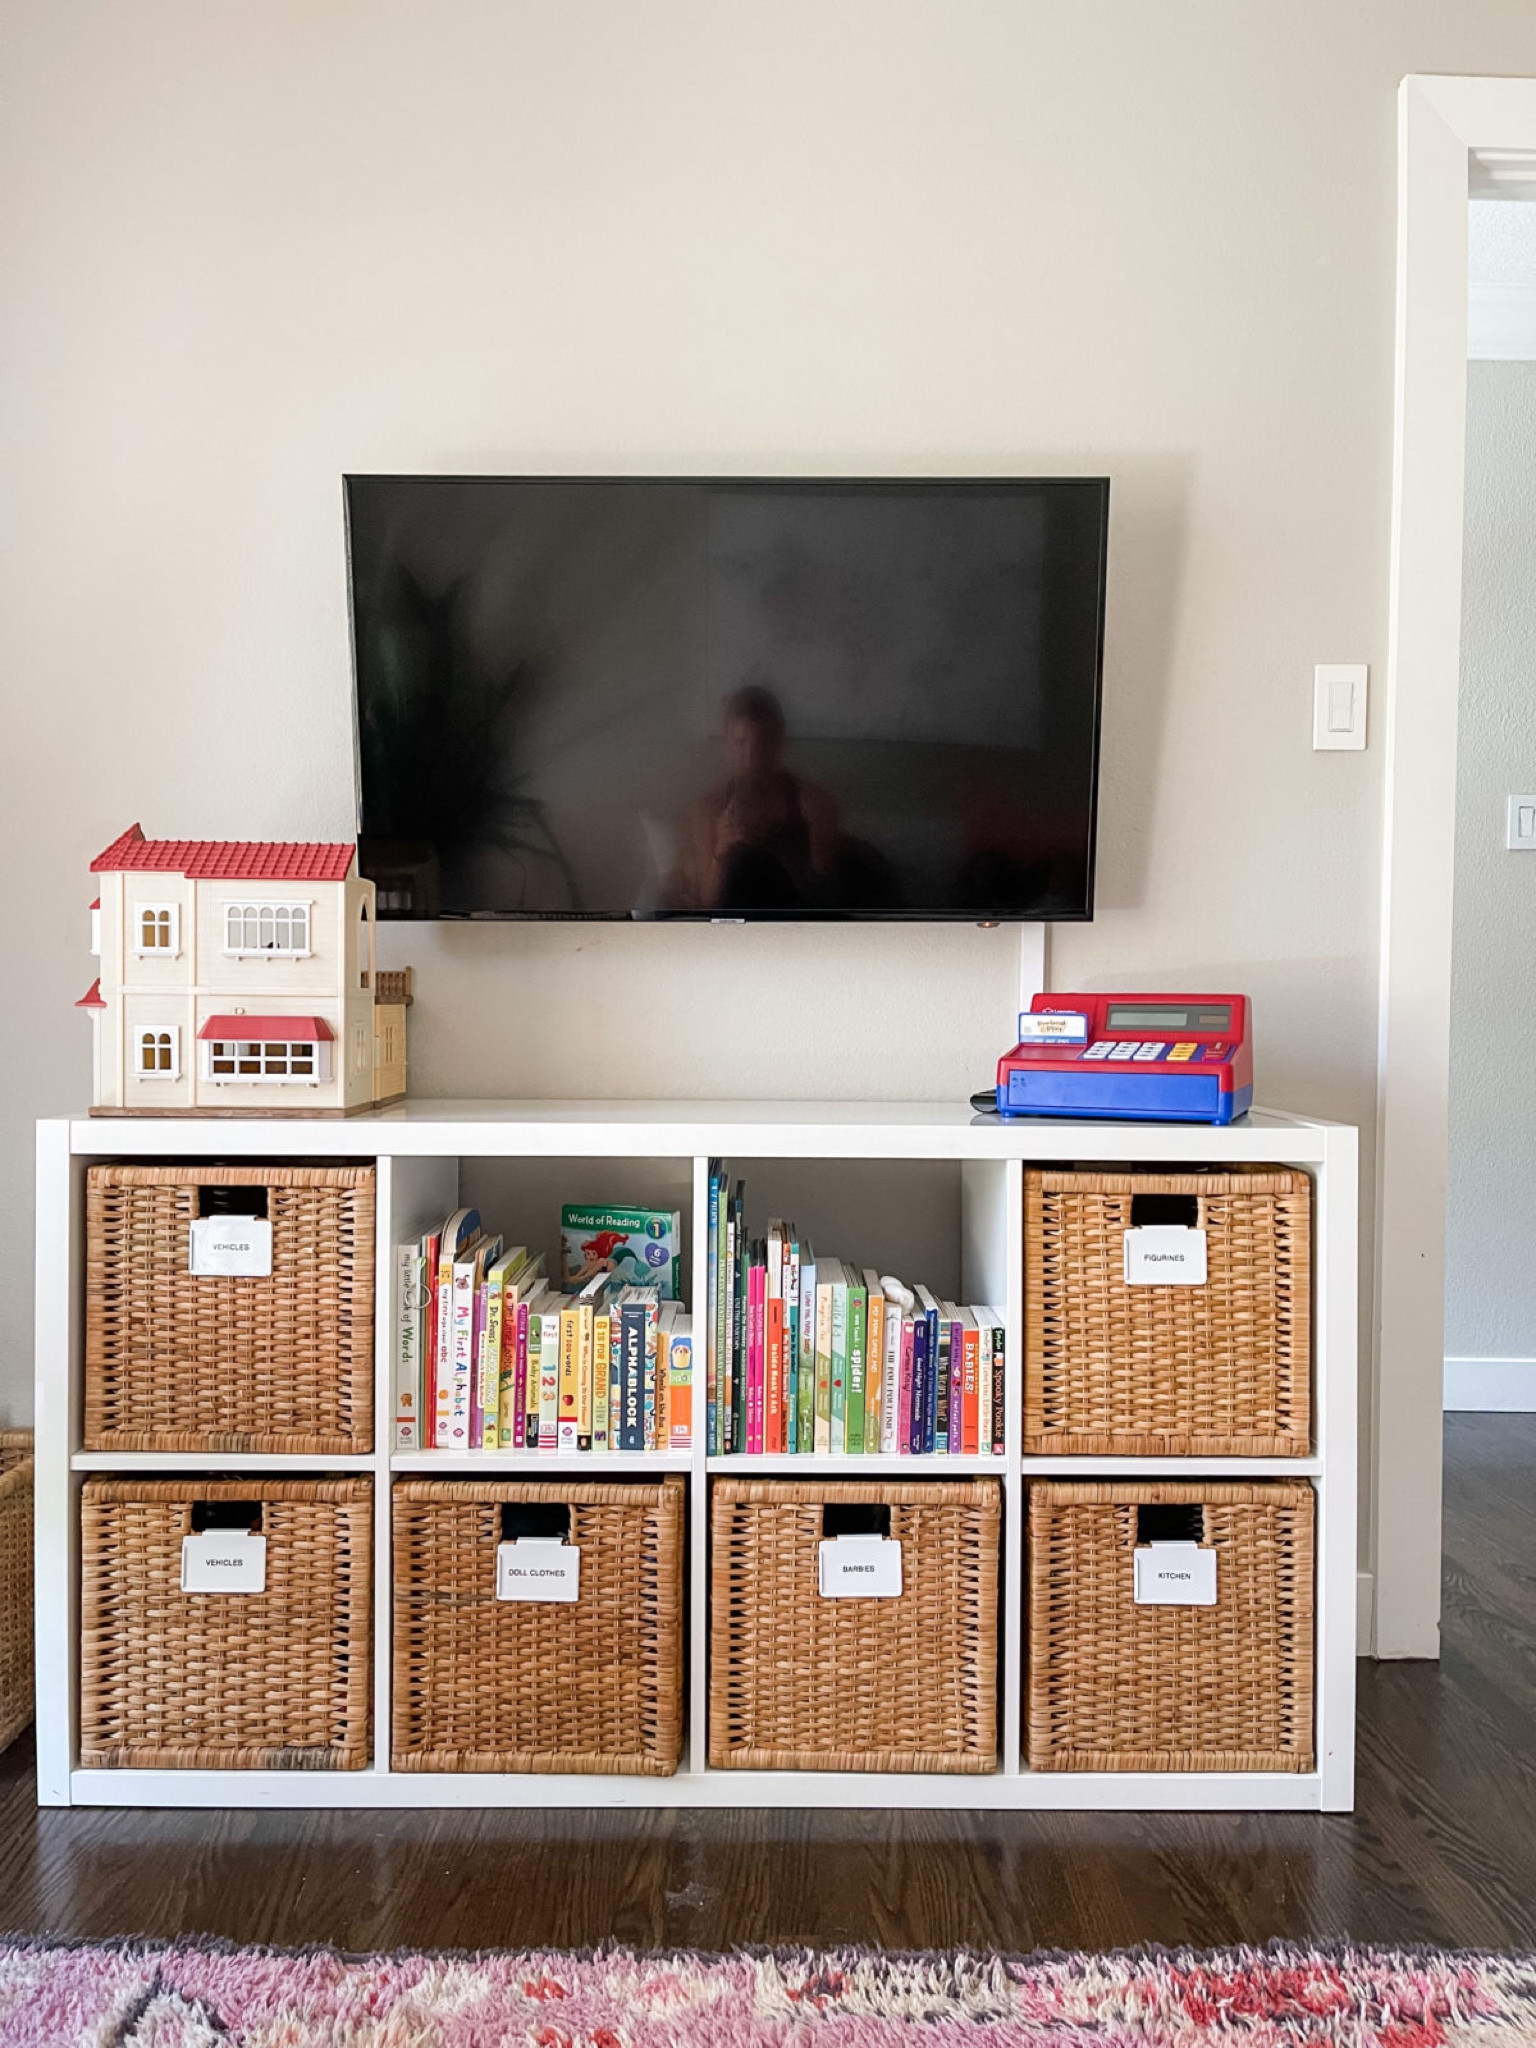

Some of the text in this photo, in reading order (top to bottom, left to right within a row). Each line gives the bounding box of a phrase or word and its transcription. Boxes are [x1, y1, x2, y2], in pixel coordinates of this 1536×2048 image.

[568, 1213, 640, 1228] World of Reading
[653, 1223, 660, 1238] 1
[213, 1243, 250, 1251] VEHICLES
[402, 1254, 411, 1267] my
[1144, 1254, 1185, 1262] FIGURINES
[403, 1270, 411, 1287] little
[401, 1314, 411, 1322] of
[490, 1306, 499, 1317] Dr.
[873, 1306, 878, 1316] MY
[489, 1320, 499, 1343] Seuss's
[566, 1320, 574, 1337] first
[597, 1321, 608, 1329] G
[597, 1331, 605, 1341] IS
[402, 1327, 414, 1363] Words
[597, 1344, 605, 1359] FOR
[453, 1306, 469, 1416] My First Alphabet
[771, 1343, 779, 1368] Inside
[905, 1346, 913, 1371] Curious
[530, 1359, 539, 1377] Baby
[565, 1354, 573, 1376] words
[851, 1349, 862, 1393] spider!
[965, 1343, 975, 1395] BABIES!
[542, 1376, 556, 1386] 2
[595, 1363, 607, 1398] GRAND
[938, 1356, 950, 1422] Who Wears What?
[993, 1369, 1004, 1404] Spooky
[530, 1380, 539, 1409] Animals
[542, 1391, 556, 1401] 3
[995, 1407, 1004, 1439] Pookie
[843, 1565, 875, 1573] BARBIES
[1158, 1572, 1191, 1580] KITCHEN
